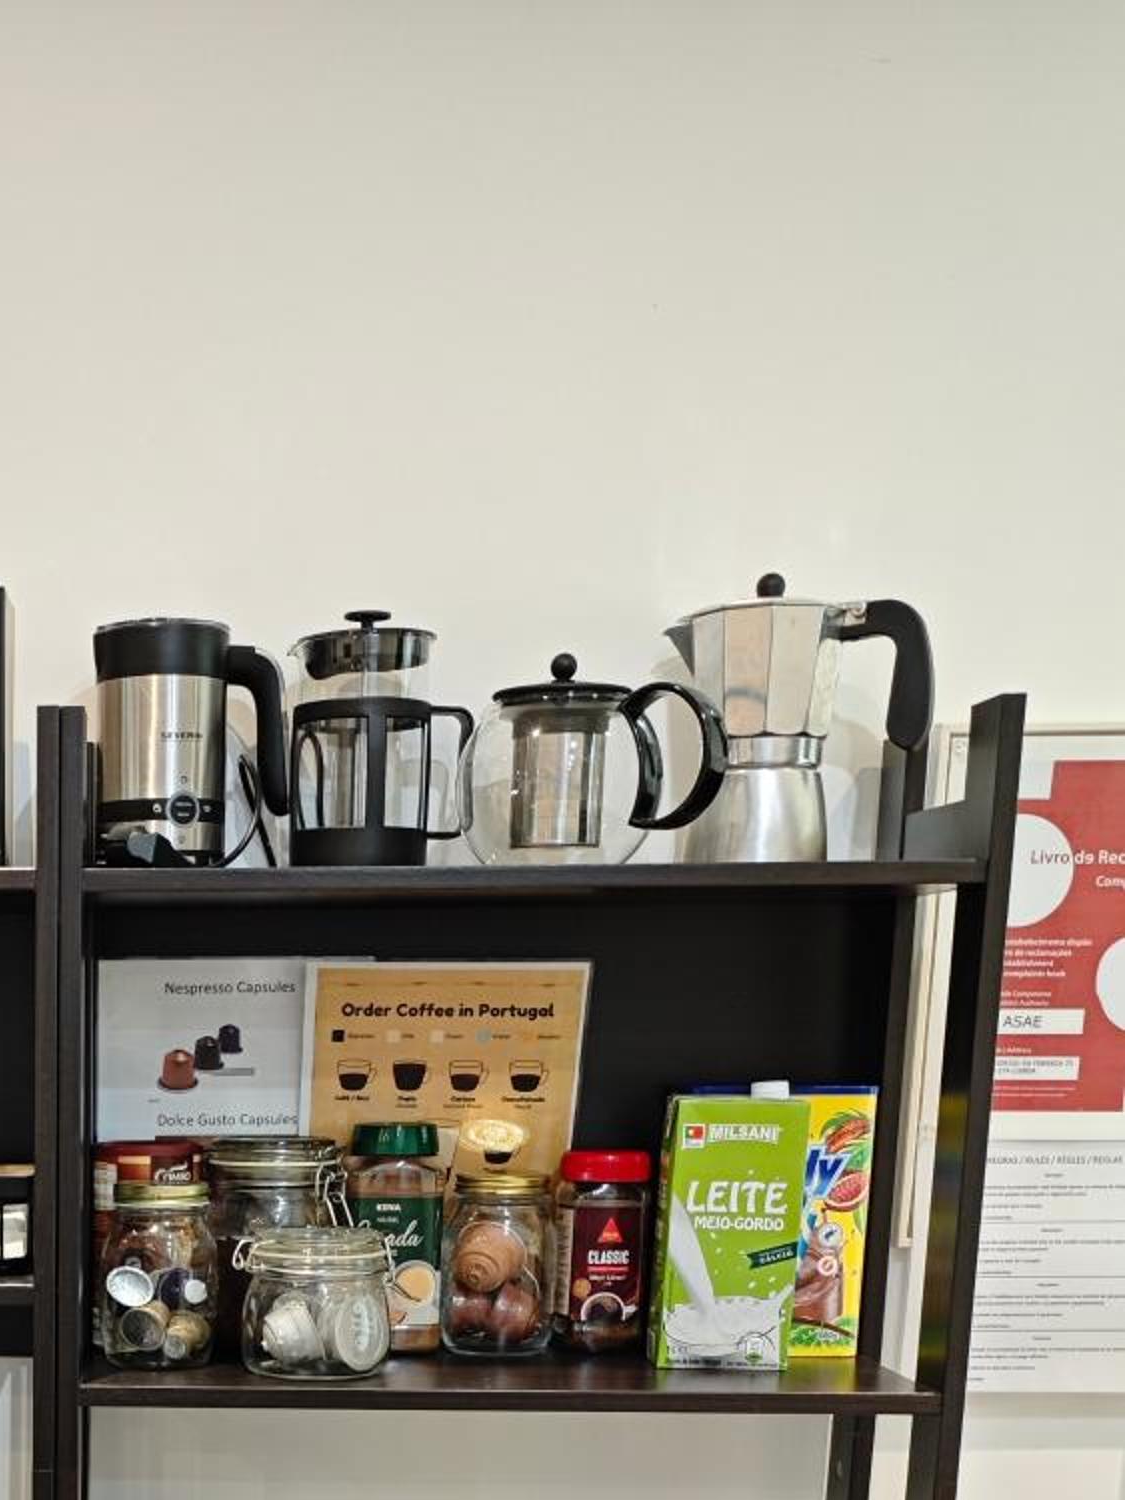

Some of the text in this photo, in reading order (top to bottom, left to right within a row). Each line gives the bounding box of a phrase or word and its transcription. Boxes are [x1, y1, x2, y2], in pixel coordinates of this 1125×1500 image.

[1030, 849, 1070, 865] Livro
[1074, 849, 1095, 865] de
[164, 981, 297, 996] Nespresso Capsules
[341, 1003, 555, 1021] Order Coffee in Portugal
[1002, 1015, 1043, 1029] ASAE
[157, 1113, 299, 1128] Dolce Gusto Capsules
[708, 1125, 779, 1143] MILSANI
[686, 1180, 788, 1215] LEITE
[694, 1216, 784, 1231] MEIO-GORDO
[588, 1249, 630, 1265] CLASSIC
